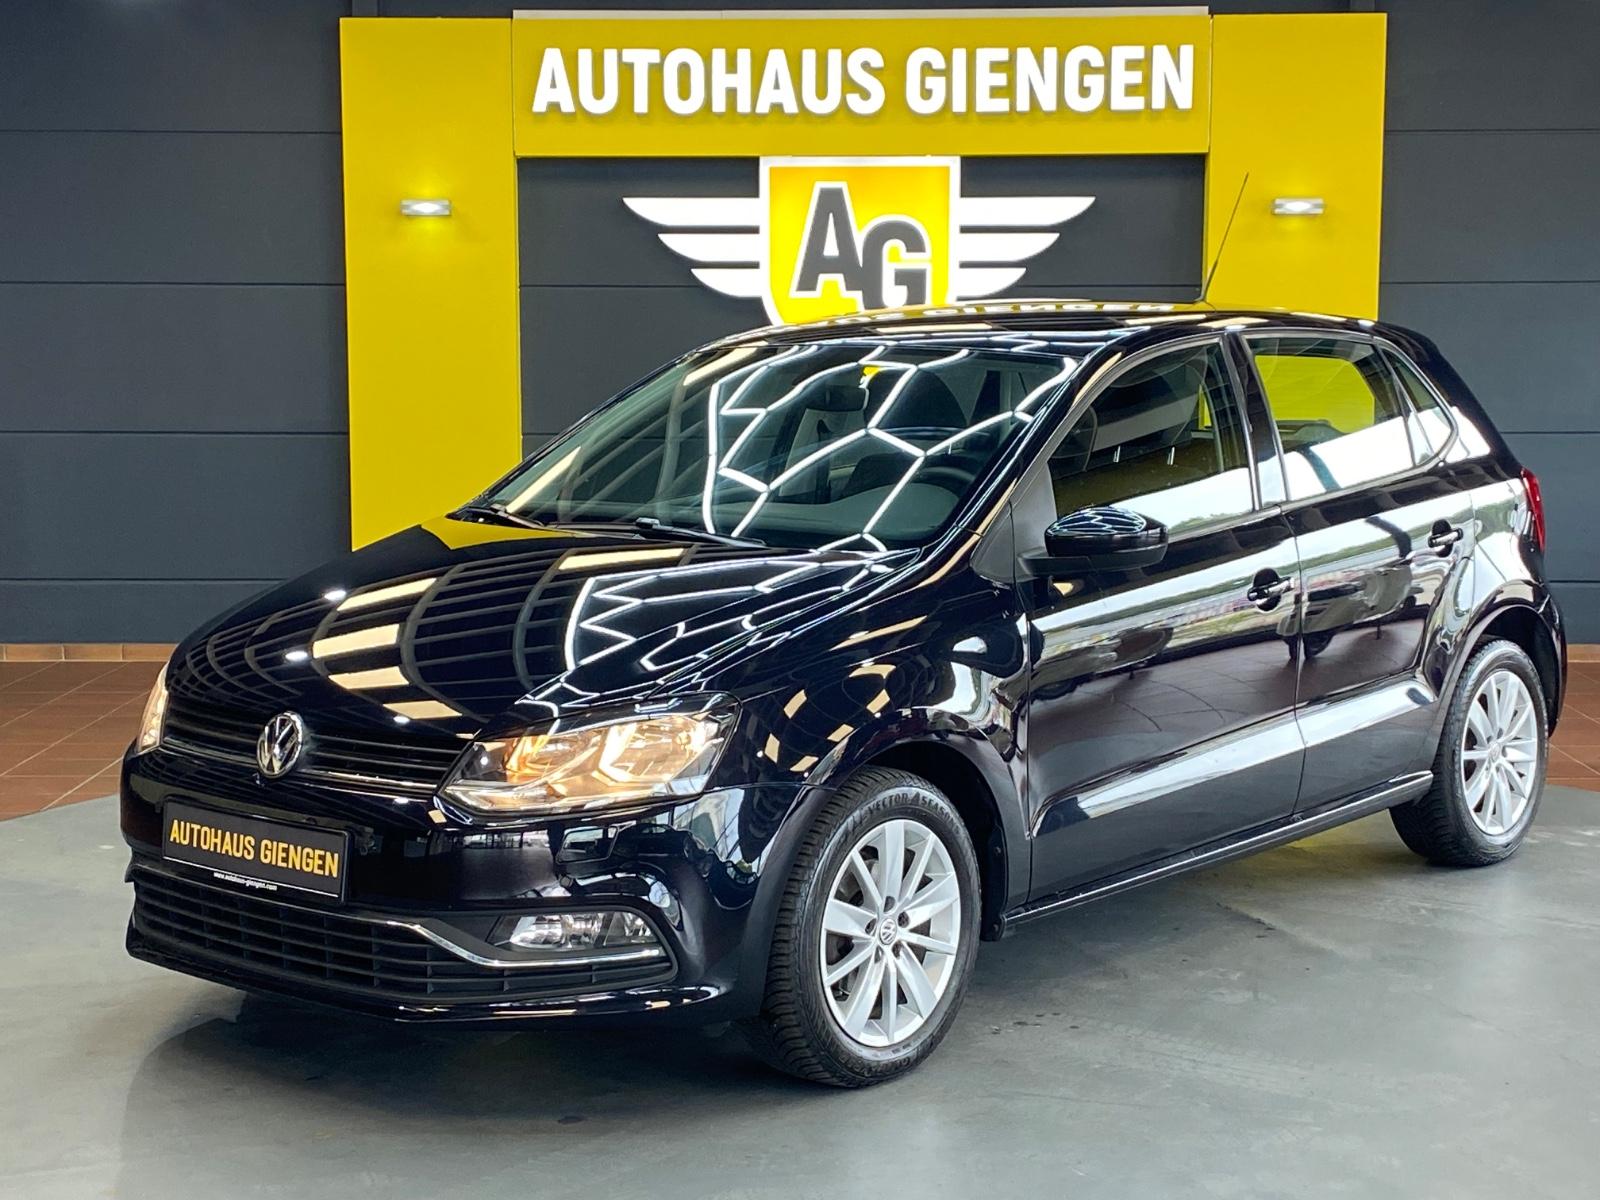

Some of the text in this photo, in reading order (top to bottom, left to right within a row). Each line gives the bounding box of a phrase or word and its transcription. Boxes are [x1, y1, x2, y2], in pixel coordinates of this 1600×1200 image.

[531, 44, 1195, 115] AUTOHAUS GIENGEN
[791, 183, 930, 310] AG
[867, 792, 909, 815] VECTOR
[169, 819, 339, 878] AUTOHAUS GIENGEN
